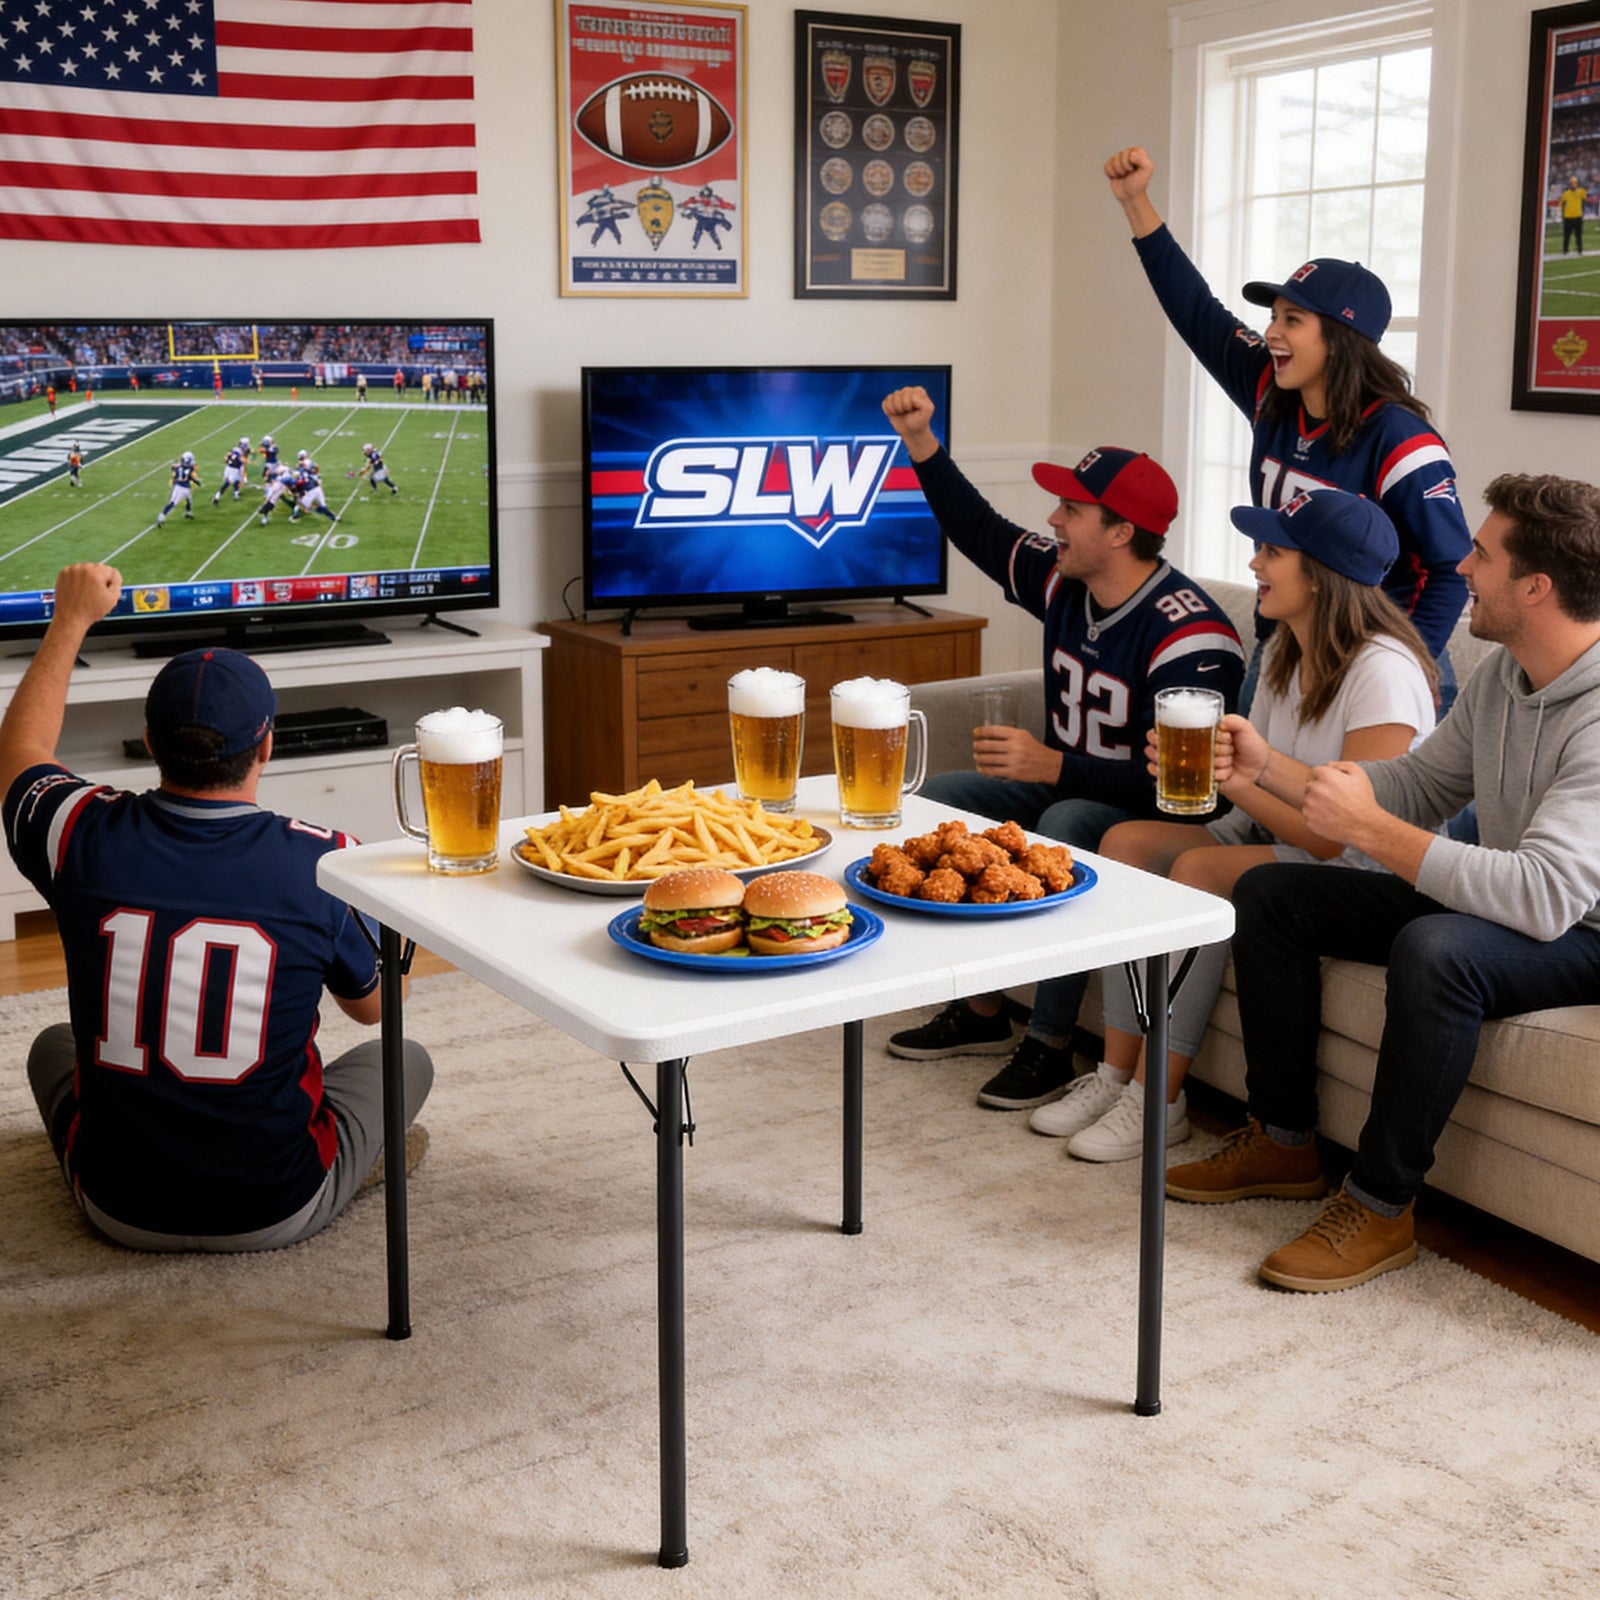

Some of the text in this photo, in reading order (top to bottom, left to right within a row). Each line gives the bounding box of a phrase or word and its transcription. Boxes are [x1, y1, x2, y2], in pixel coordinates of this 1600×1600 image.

[648, 444, 889, 518] SLW
[1052, 647, 1132, 760] 32
[95, 906, 278, 1083] 10
